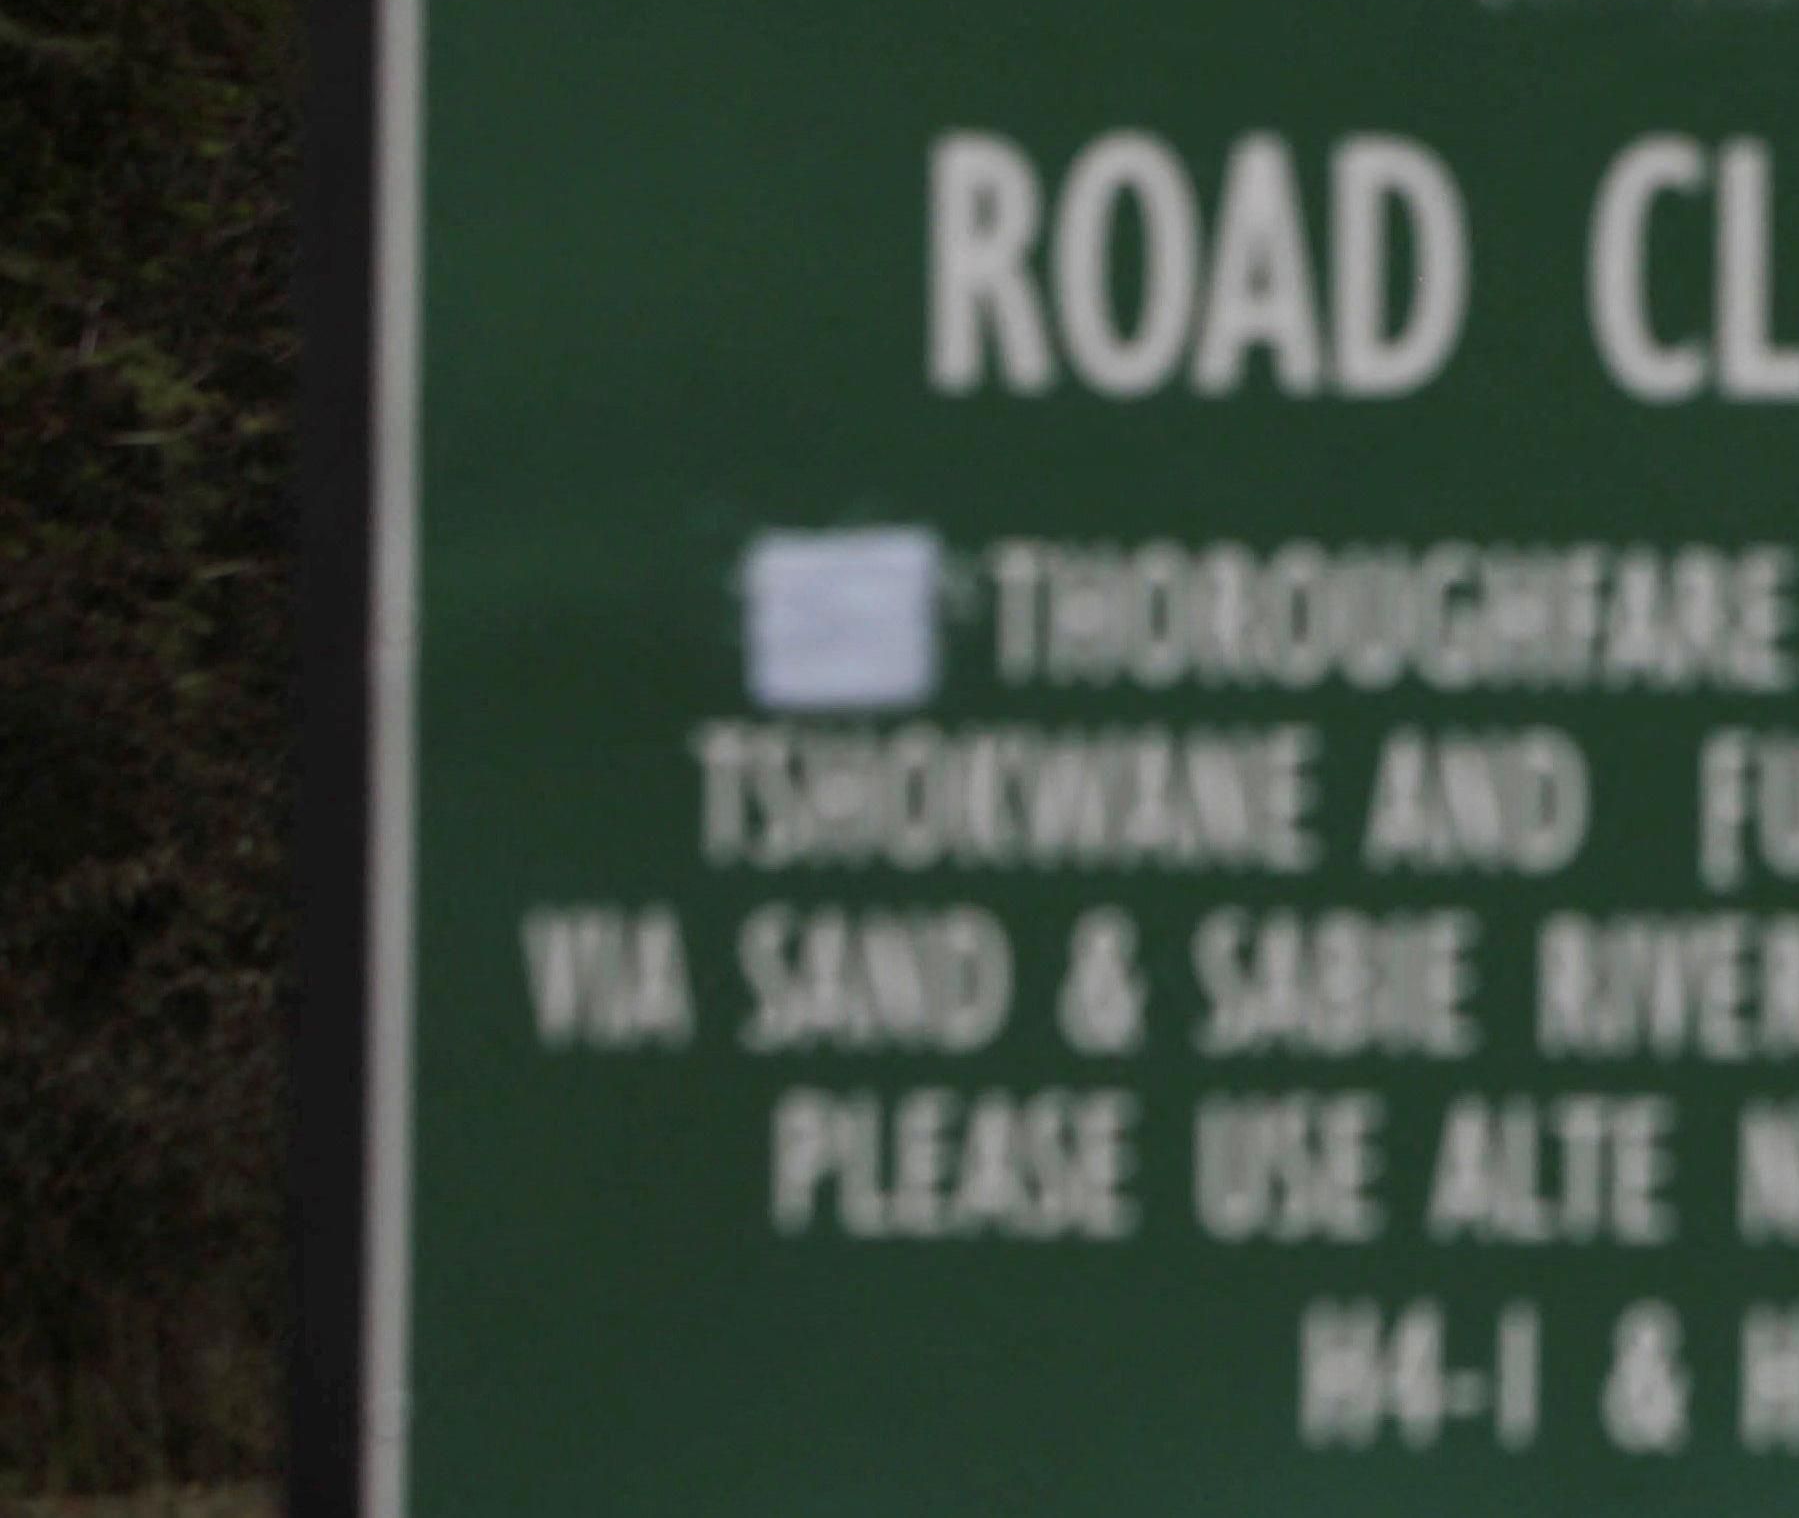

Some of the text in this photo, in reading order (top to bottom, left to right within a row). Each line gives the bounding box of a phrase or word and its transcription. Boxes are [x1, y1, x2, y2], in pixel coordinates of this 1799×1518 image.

[926, 128, 1471, 400] ROAD
[988, 539, 1795, 694] THOROUGHFARE
[694, 720, 1318, 872] TSHOKWANE
[1363, 726, 1592, 876] AND
[522, 906, 697, 1050] VIA
[738, 906, 1015, 1052] SAND
[1058, 906, 1146, 1054] &
[1192, 908, 1480, 1056] SABIE
[771, 1086, 1140, 1239] PLEASE
[1193, 1092, 1386, 1242] USE
[1600, 1300, 1692, 1454] &
